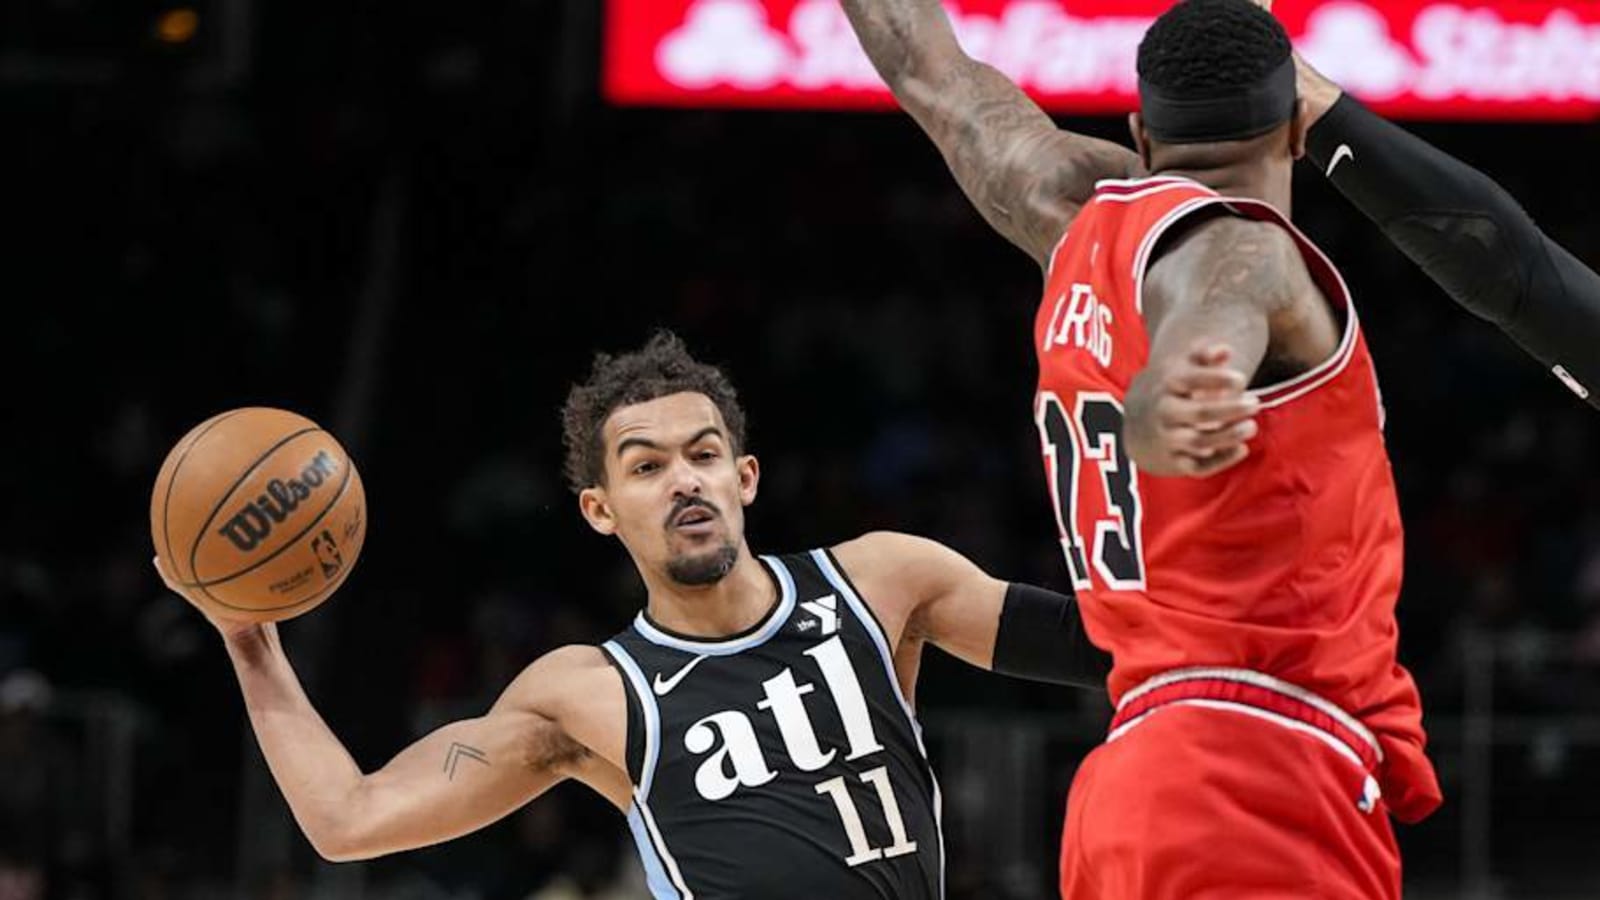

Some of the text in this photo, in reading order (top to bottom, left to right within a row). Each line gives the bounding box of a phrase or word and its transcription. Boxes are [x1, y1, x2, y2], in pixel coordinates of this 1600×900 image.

[218, 450, 337, 551] Wilson
[1035, 391, 1147, 591] 13
[684, 634, 884, 801] atl
[814, 765, 918, 867] 11
